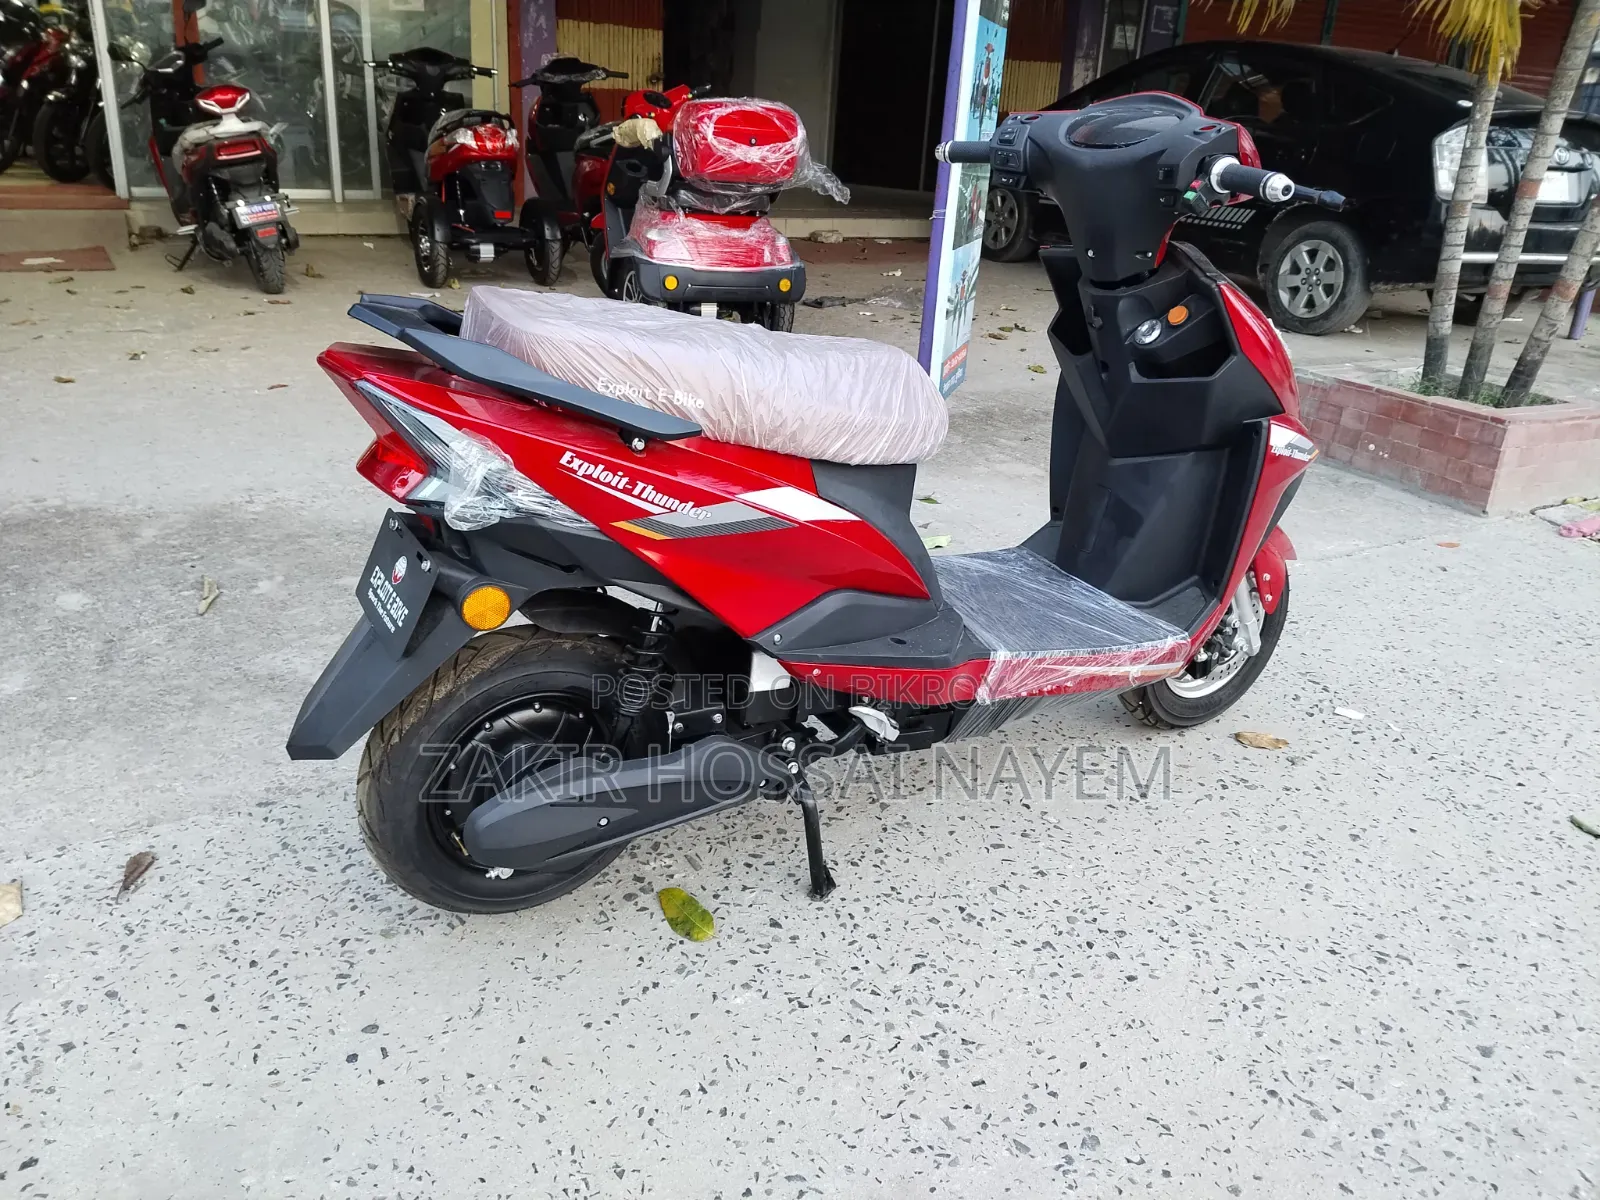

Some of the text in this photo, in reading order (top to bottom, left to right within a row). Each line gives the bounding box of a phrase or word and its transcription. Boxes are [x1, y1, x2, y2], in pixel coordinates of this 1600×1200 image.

[597, 377, 705, 409] Exploit E-Bike
[559, 451, 712, 521] Exploit-Thunder
[370, 565, 394, 603] EXPLOIT
